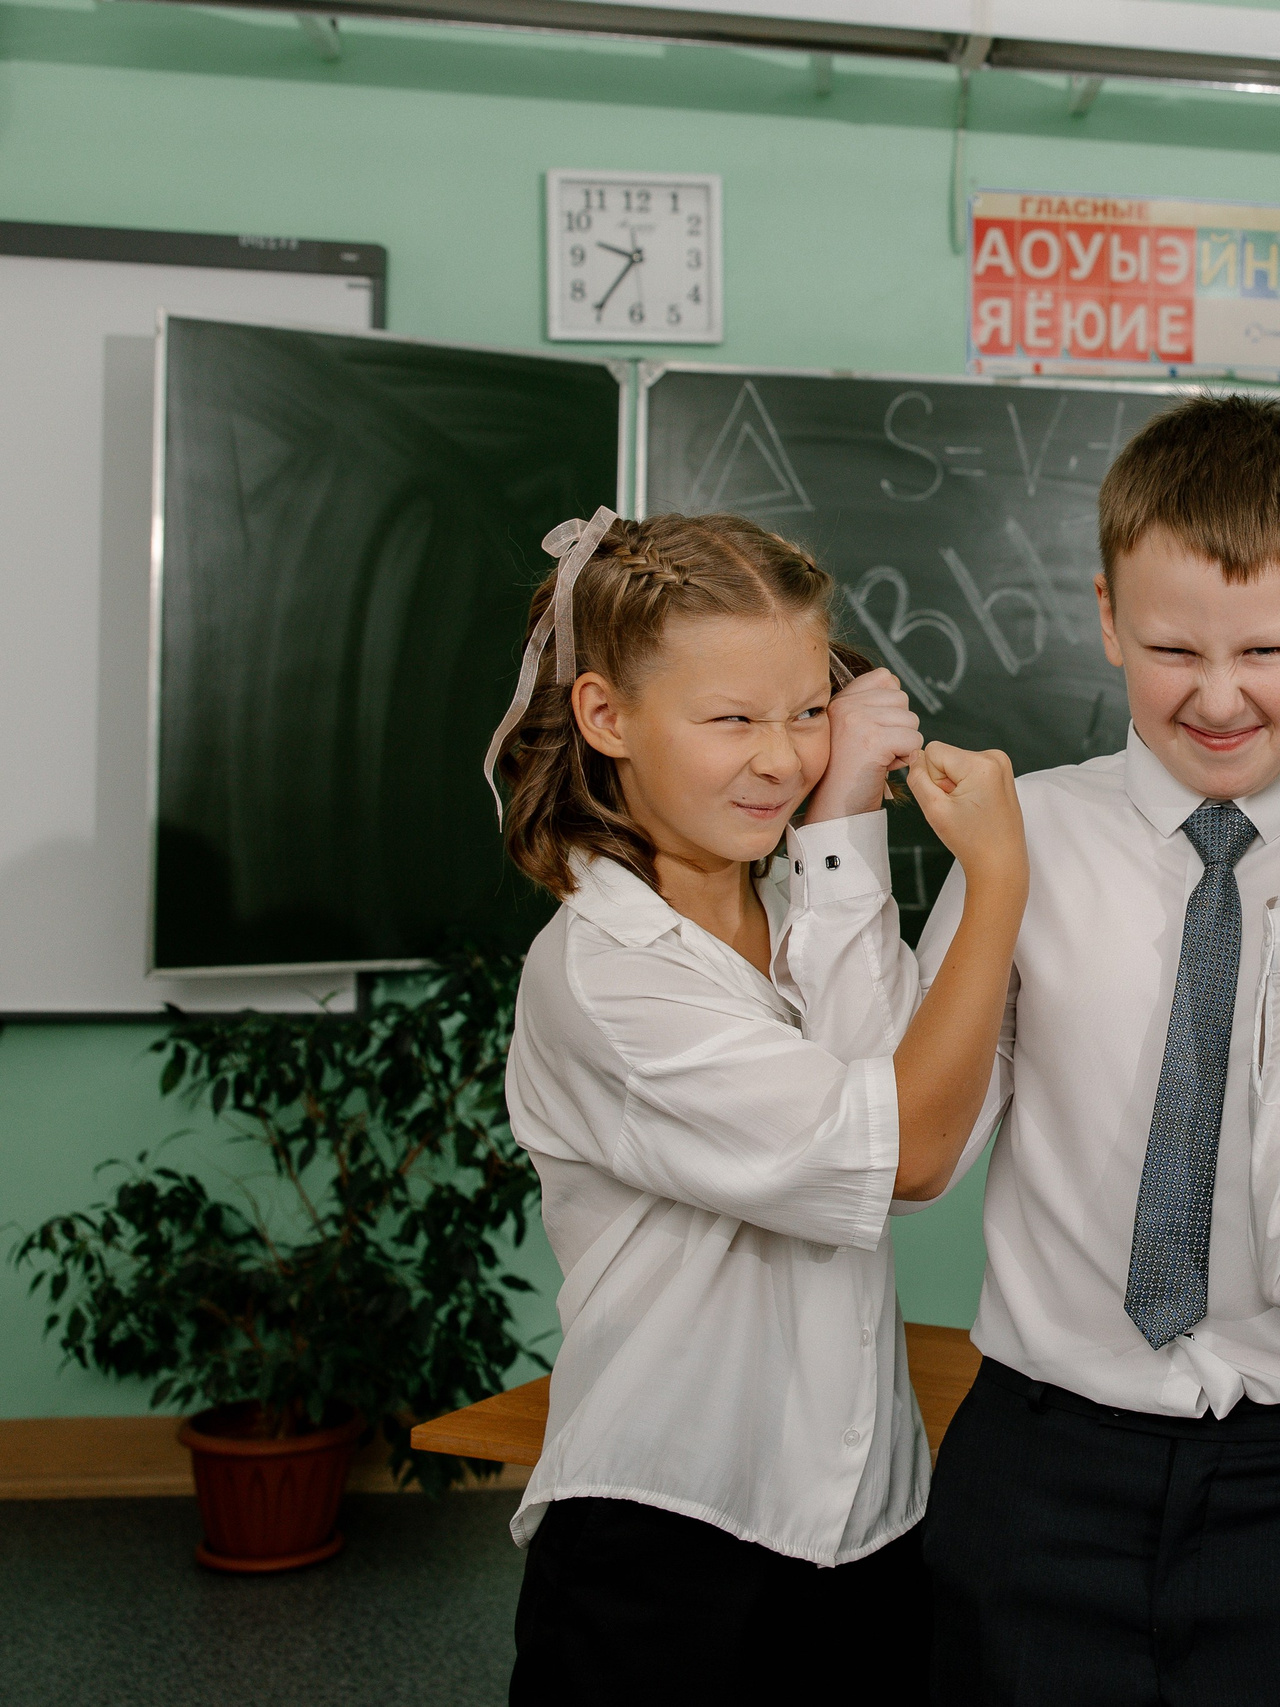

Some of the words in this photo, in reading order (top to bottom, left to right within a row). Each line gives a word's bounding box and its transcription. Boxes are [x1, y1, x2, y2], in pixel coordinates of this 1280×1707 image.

[583, 188, 606, 211] 11
[624, 189, 651, 213] 12
[671, 191, 679, 213] 1
[1021, 196, 1149, 222] ГЛАСНЫЕ
[566, 210, 592, 232] 10
[687, 214, 701, 236] 2
[570, 245, 585, 266] 9
[687, 248, 701, 269] 3
[571, 279, 586, 301] 8
[687, 285, 701, 304] 4
[629, 303, 644, 324] 6
[667, 304, 681, 324] 5
